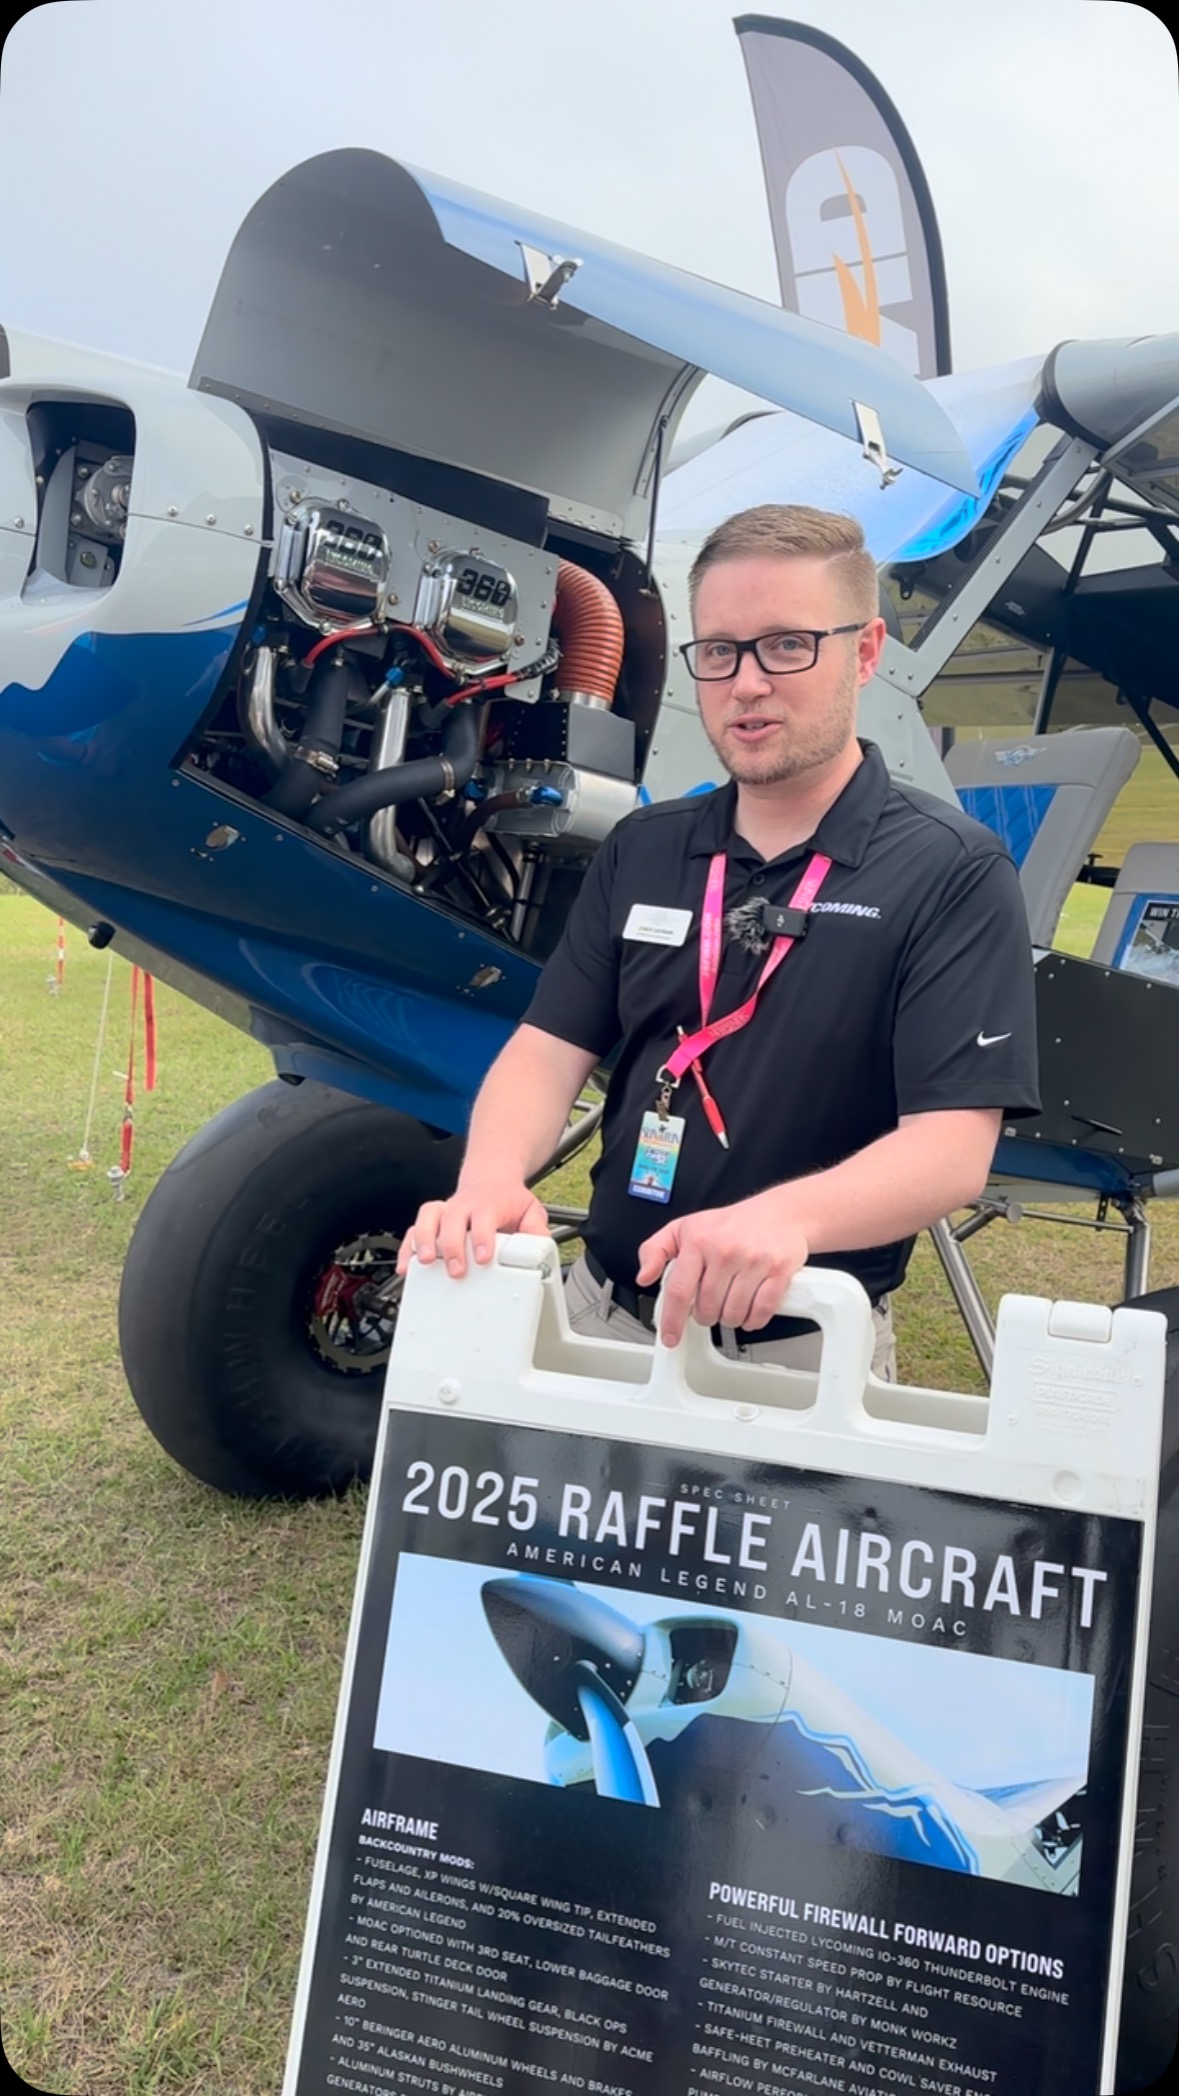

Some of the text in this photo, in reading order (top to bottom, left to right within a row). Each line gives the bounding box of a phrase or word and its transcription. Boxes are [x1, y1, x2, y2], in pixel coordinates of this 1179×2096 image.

[459, 569, 512, 605] 360
[680, 1482, 791, 1510] SPEC SHEET
[402, 1461, 1107, 1627] 2025 RAFFLE AIRCRAFT
[506, 1541, 967, 1637] AMERICAN LEGEND AL-18 MOAC
[358, 1834, 475, 1870] BACKCOUNTRY MODS:
[360, 1807, 440, 1841] AIRFRAME
[350, 1893, 467, 1930] BY AMERICAN LEGEND
[352, 1873, 671, 1958] FLAPS AND AILERONS, AND 20% OVERSIZED TAILFEATHERS
[364, 1855, 657, 1934] FUSELAGE, XP WINGS W/SQUARE WING TIP, EXTENDED
[708, 1881, 1065, 1980] POWERFUL FIREWALL FORWARD OPTIONS
[344, 1933, 508, 1982] AND REAR TURTLE DECK DOOR
[356, 1915, 669, 2001] MOAC OPTIONED WITH 3RD SEAT, LOWER BAGGAGE DOOR
[711, 1957, 930, 2019] SKYTEC STARTER BY HARTZELL AND
[713, 1935, 1023, 2019] M/T CONSTANT SPEED PROP BY FLIGHT RESOURCE
[716, 1913, 1070, 2006] FUEL INJECTED LYCOMING IO-360 THUNDERBOLT ENGINE
[336, 1993, 367, 2009] AERO
[339, 1972, 654, 2063] SUSPENSION, STINGER TAIL WHEEL SUSPENSION BY ACME
[365, 1957, 421, 1981] EXTENDED
[423, 1972, 475, 1995] TITANIUM
[476, 1986, 526, 2009] LANDING
[527, 1999, 562, 2019] GEAR,
[564, 2008, 602, 2028] BLACK
[603, 2018, 628, 2035] OPS
[698, 1977, 958, 2050] GENERATOR/REGULATOR BY MONK WORKZ
[331, 2033, 355, 2048] AND
[376, 2045, 427, 2067] ALASKAN
[428, 2058, 504, 2089] BUSHWHEELS
[337, 2056, 396, 2080] ALUMINUM
[397, 2071, 440, 2092] STRUTS
[441, 2083, 457, 2096] BY
[362, 2019, 415, 2042] BERINGER
[416, 2034, 447, 2051] AERO
[448, 2043, 509, 2068] ALUMINUM
[510, 2059, 558, 2081] WHEELS
[559, 2073, 586, 2089] AND
[587, 2079, 633, 2096] BRAKES
[691, 2042, 750, 2067] BAFFLING
[752, 2057, 770, 2071] BY
[771, 2062, 846, 2092] MCFARLANE
[703, 2022, 772, 2049] SAFE-HEET
[774, 2040, 846, 2069] PREHEATER
[847, 2059, 876, 2076] AND
[878, 2067, 917, 2088] COWL
[918, 2075, 962, 2096] SAVER
[706, 2000, 998, 2083] TITANIUM FIREWALL AND VETTERMAN EXHAUST
[698, 2067, 754, 2091] AIRFLOW
